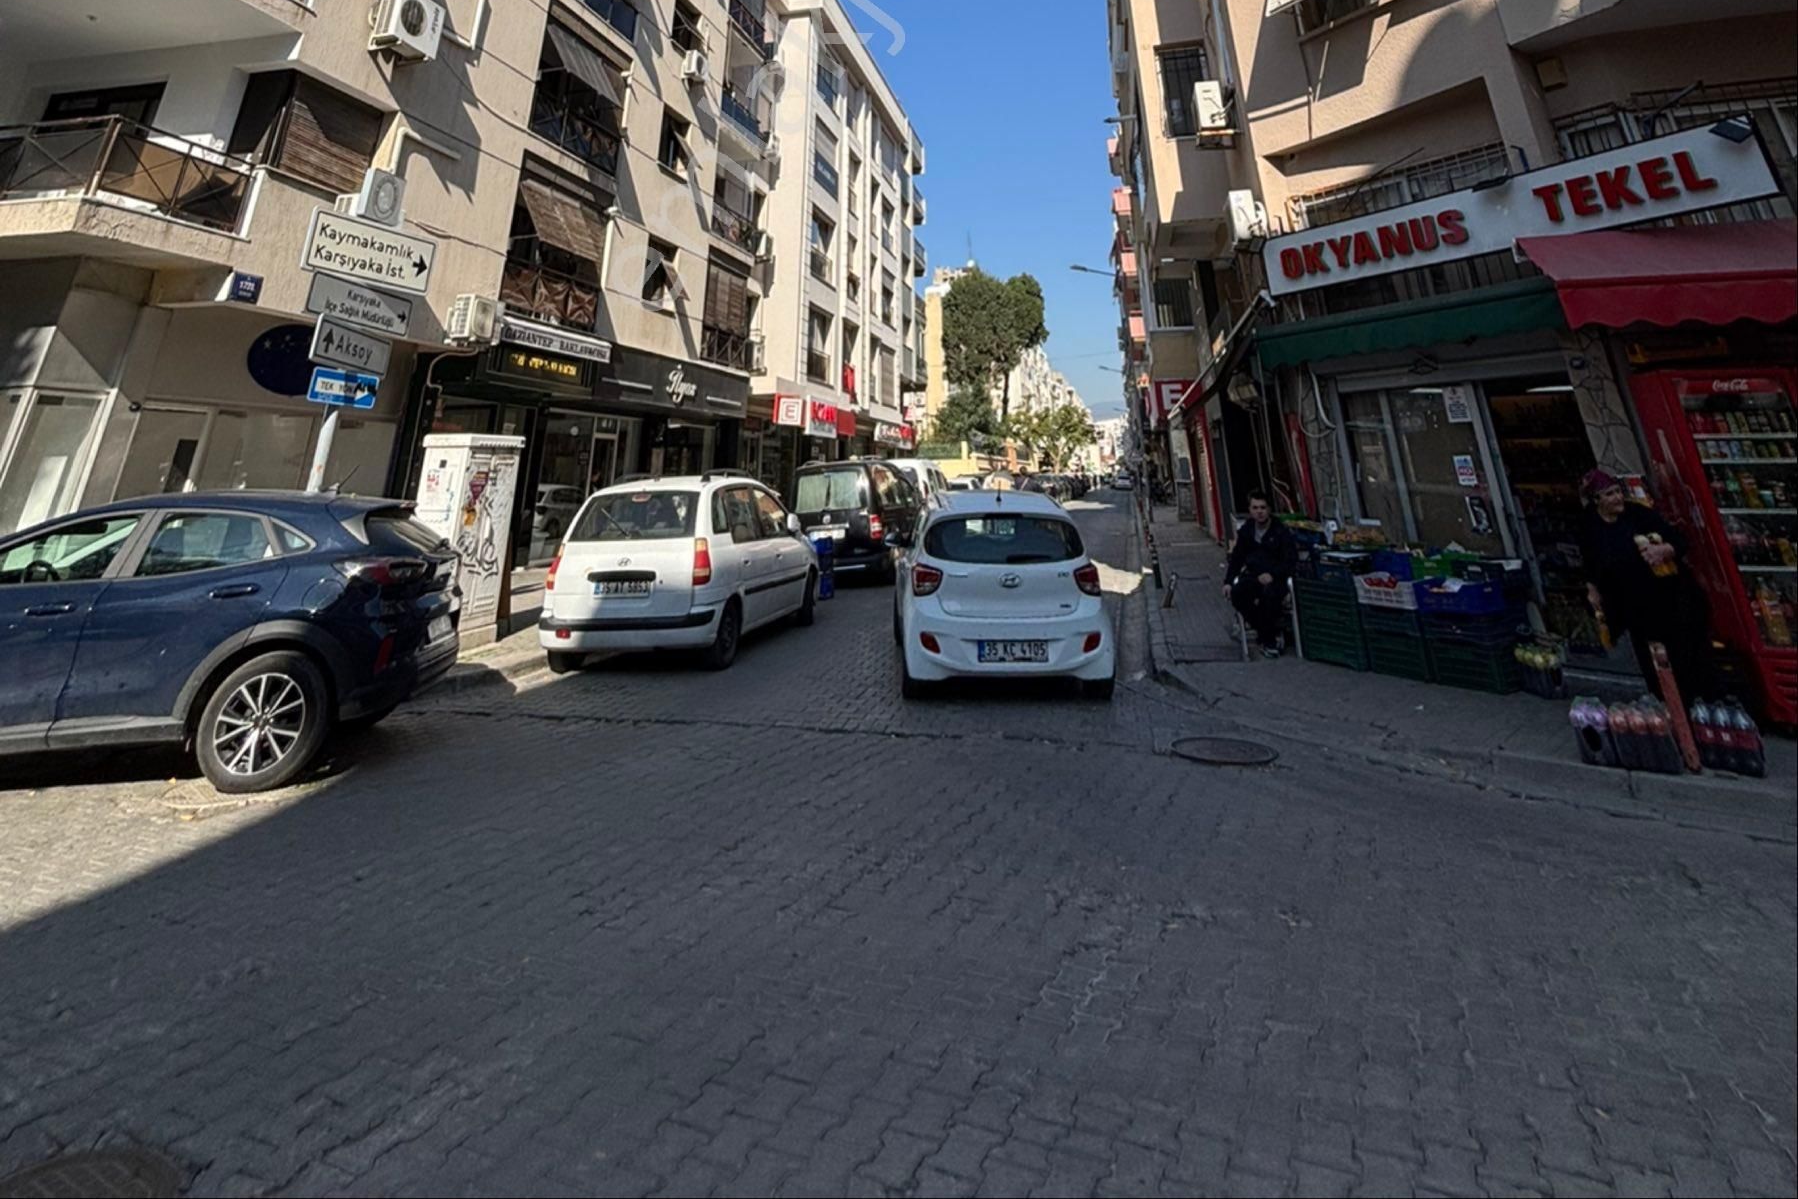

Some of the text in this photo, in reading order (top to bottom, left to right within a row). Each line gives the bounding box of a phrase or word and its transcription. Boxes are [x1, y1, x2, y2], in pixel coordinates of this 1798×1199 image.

[1279, 150, 1718, 281] OKYANUS TEKEL
[318, 222, 415, 260] Kaymakamlık
[314, 243, 406, 280] Karşıyaka İst.
[334, 334, 374, 366] Aksoy
[785, 404, 796, 419] E
[986, 642, 999, 656] 35
[1020, 642, 1046, 656] 4105
